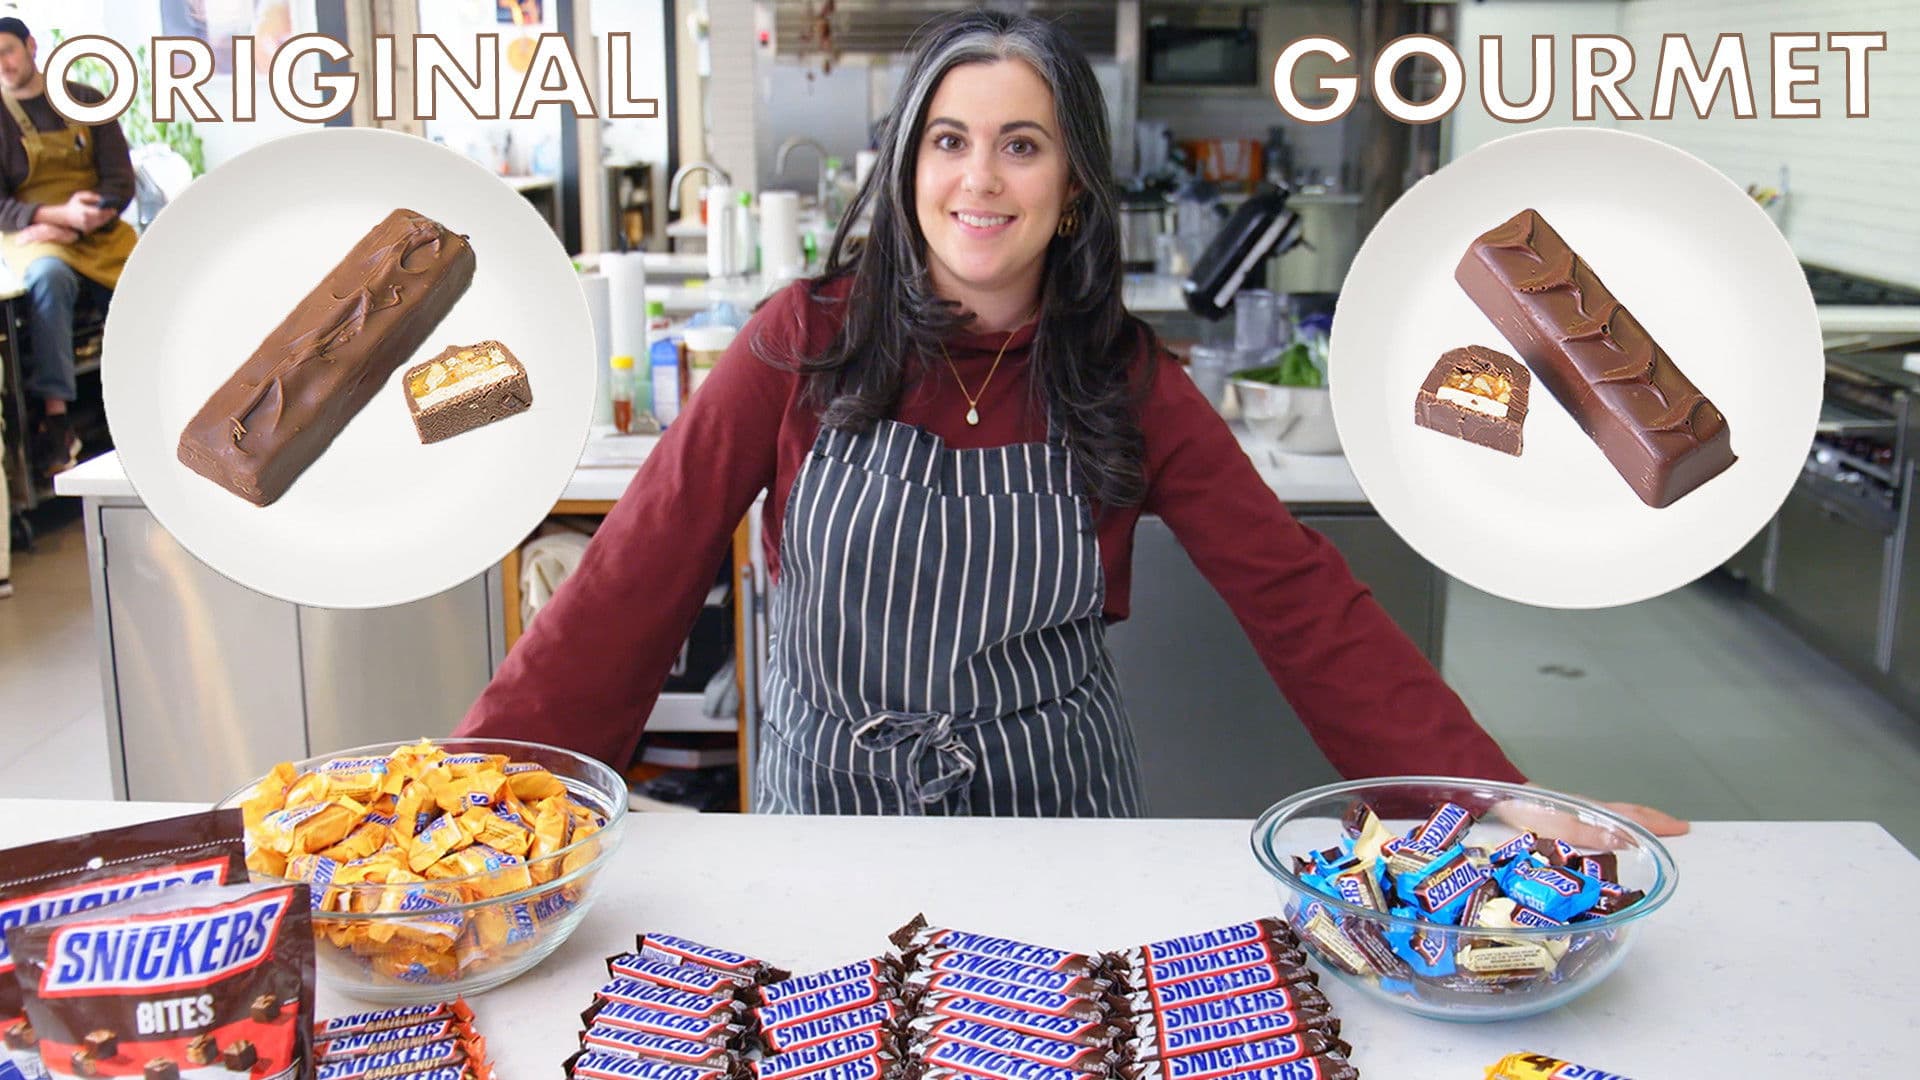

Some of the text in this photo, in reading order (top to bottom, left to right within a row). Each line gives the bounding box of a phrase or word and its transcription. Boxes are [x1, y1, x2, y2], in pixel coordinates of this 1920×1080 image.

[58, 904, 279, 985] SNICKERS
[942, 930, 1071, 967] SNICKERS
[1151, 921, 1258, 959] SNICKERS
[767, 960, 872, 1001] SNICKERS
[943, 953, 1078, 989] SNICKERS
[1155, 944, 1265, 981] SNICKERS
[601, 978, 714, 1011] SNICKERS
[761, 979, 872, 1026] SNICKERS
[939, 973, 1076, 1008] SNICKERS
[1160, 965, 1273, 1004] SNICKERS
[136, 994, 216, 1034] BITES
[599, 1002, 711, 1033] SNICKERS
[776, 1003, 888, 1048] SNICKERS
[948, 997, 1089, 1034] SNICKERS
[1165, 990, 1285, 1029] SNICKERS
[330, 1021, 445, 1052] SNICKERS
[945, 1020, 1087, 1060] SNICKERS
[1168, 1013, 1291, 1048] SNICKERS
[319, 1039, 453, 1080] SNICKERS
[760, 1031, 874, 1076] SNICKERS
[937, 1042, 1083, 1080] SNICKERS
[1173, 1033, 1297, 1077] SNICKERS
